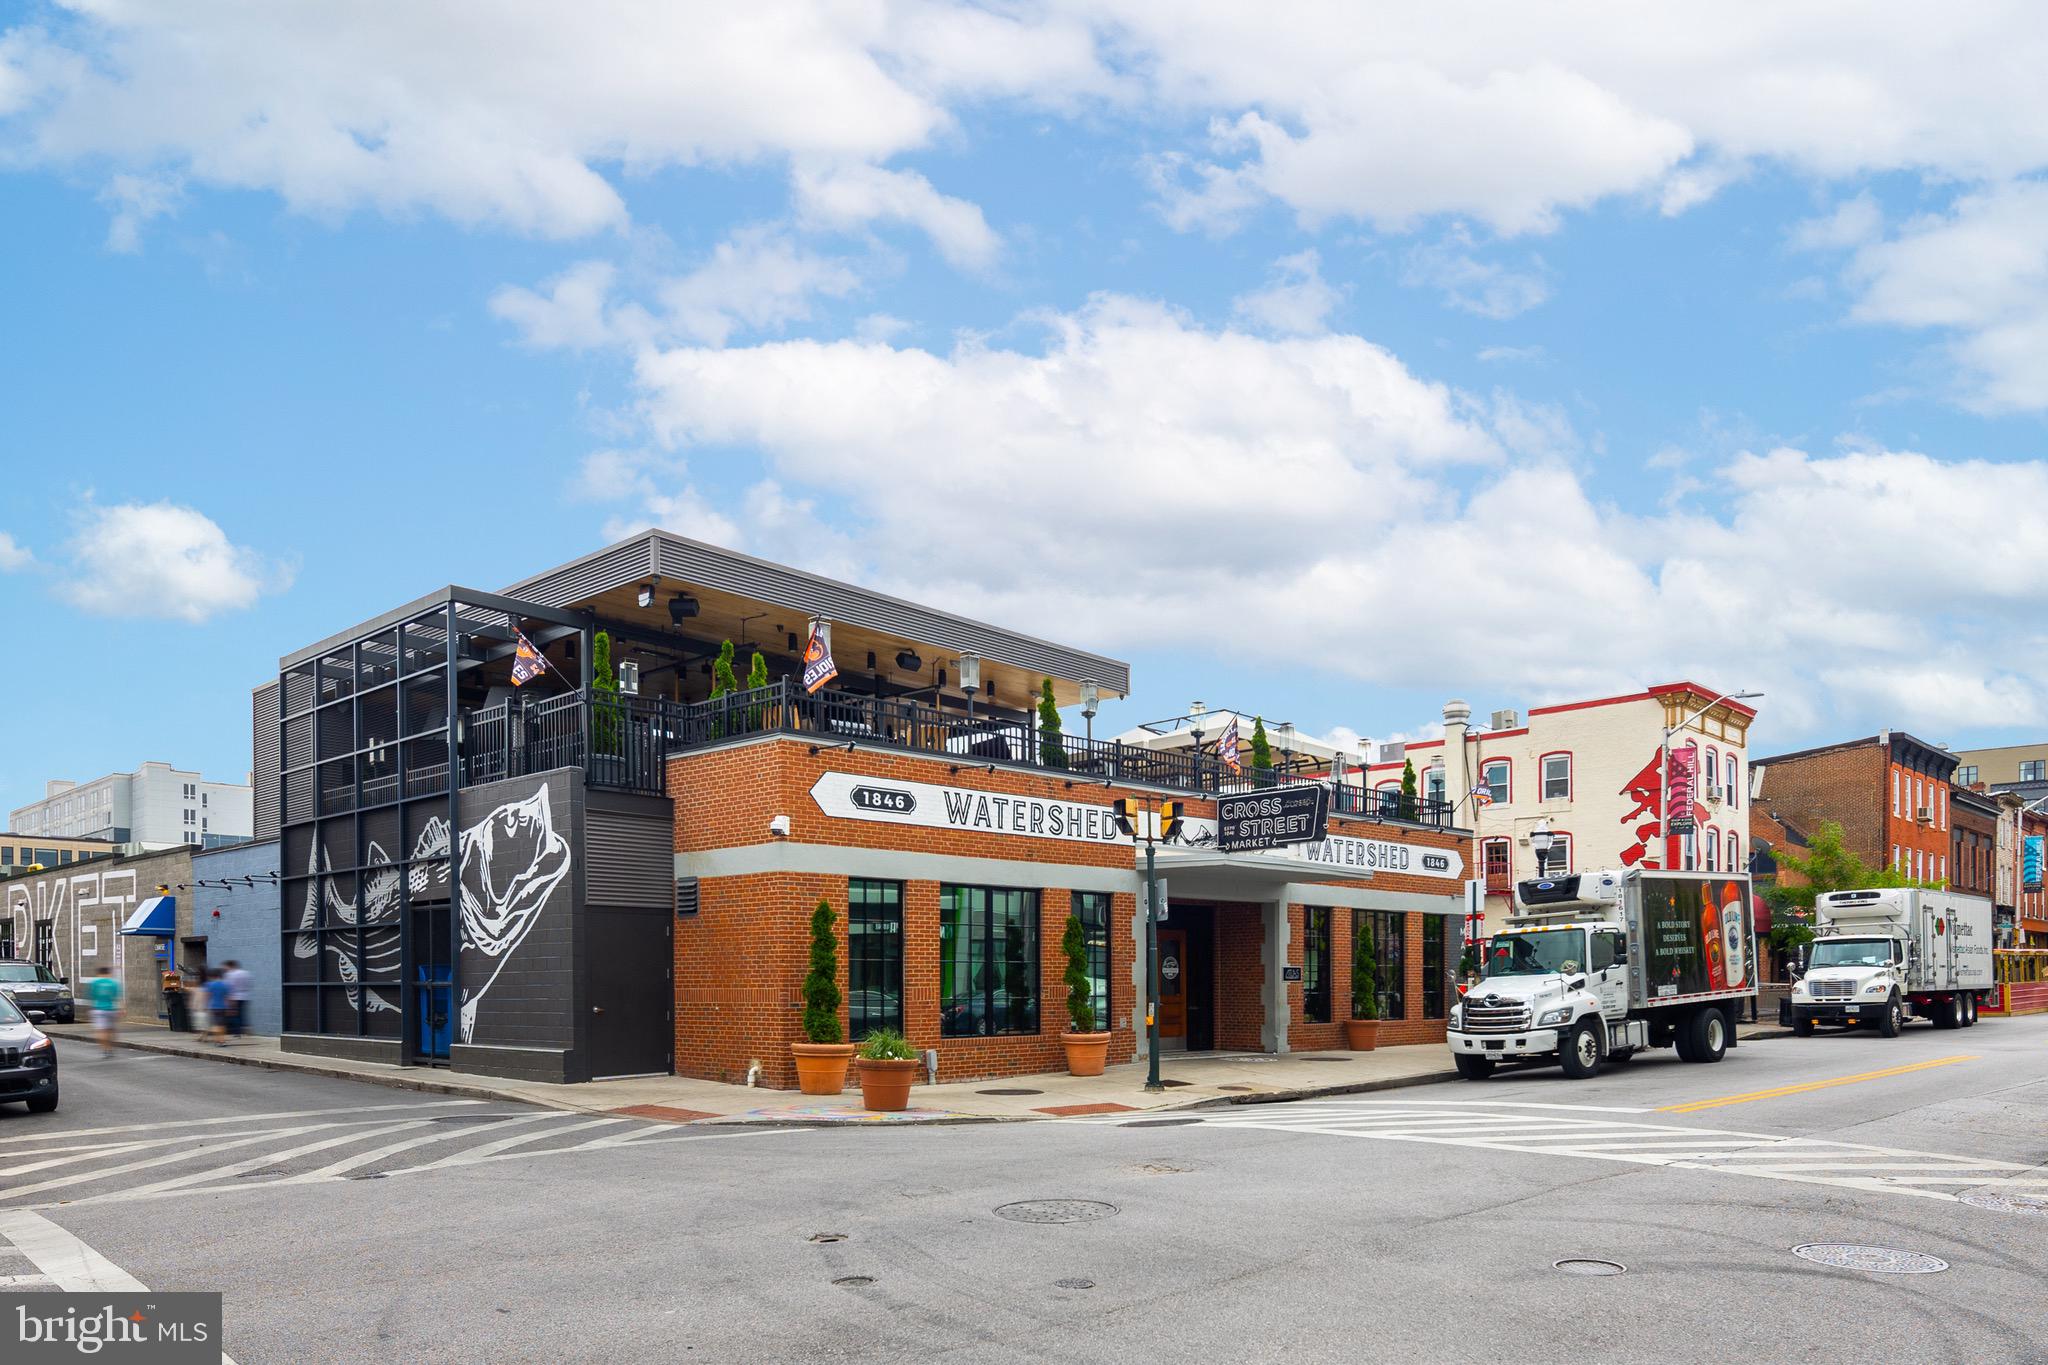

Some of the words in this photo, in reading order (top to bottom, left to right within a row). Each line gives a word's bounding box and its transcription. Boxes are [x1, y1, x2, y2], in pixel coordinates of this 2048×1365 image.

[1687, 752, 1695, 771] HILL
[862, 791, 905, 809] 1846
[1222, 797, 1283, 820] CROSS
[943, 790, 1117, 841] WATERSHED
[1240, 813, 1309, 837] STREET
[1231, 837, 1270, 849] MARKET
[1306, 838, 1410, 870] WATERSHED
[1426, 857, 1445, 869] 1846
